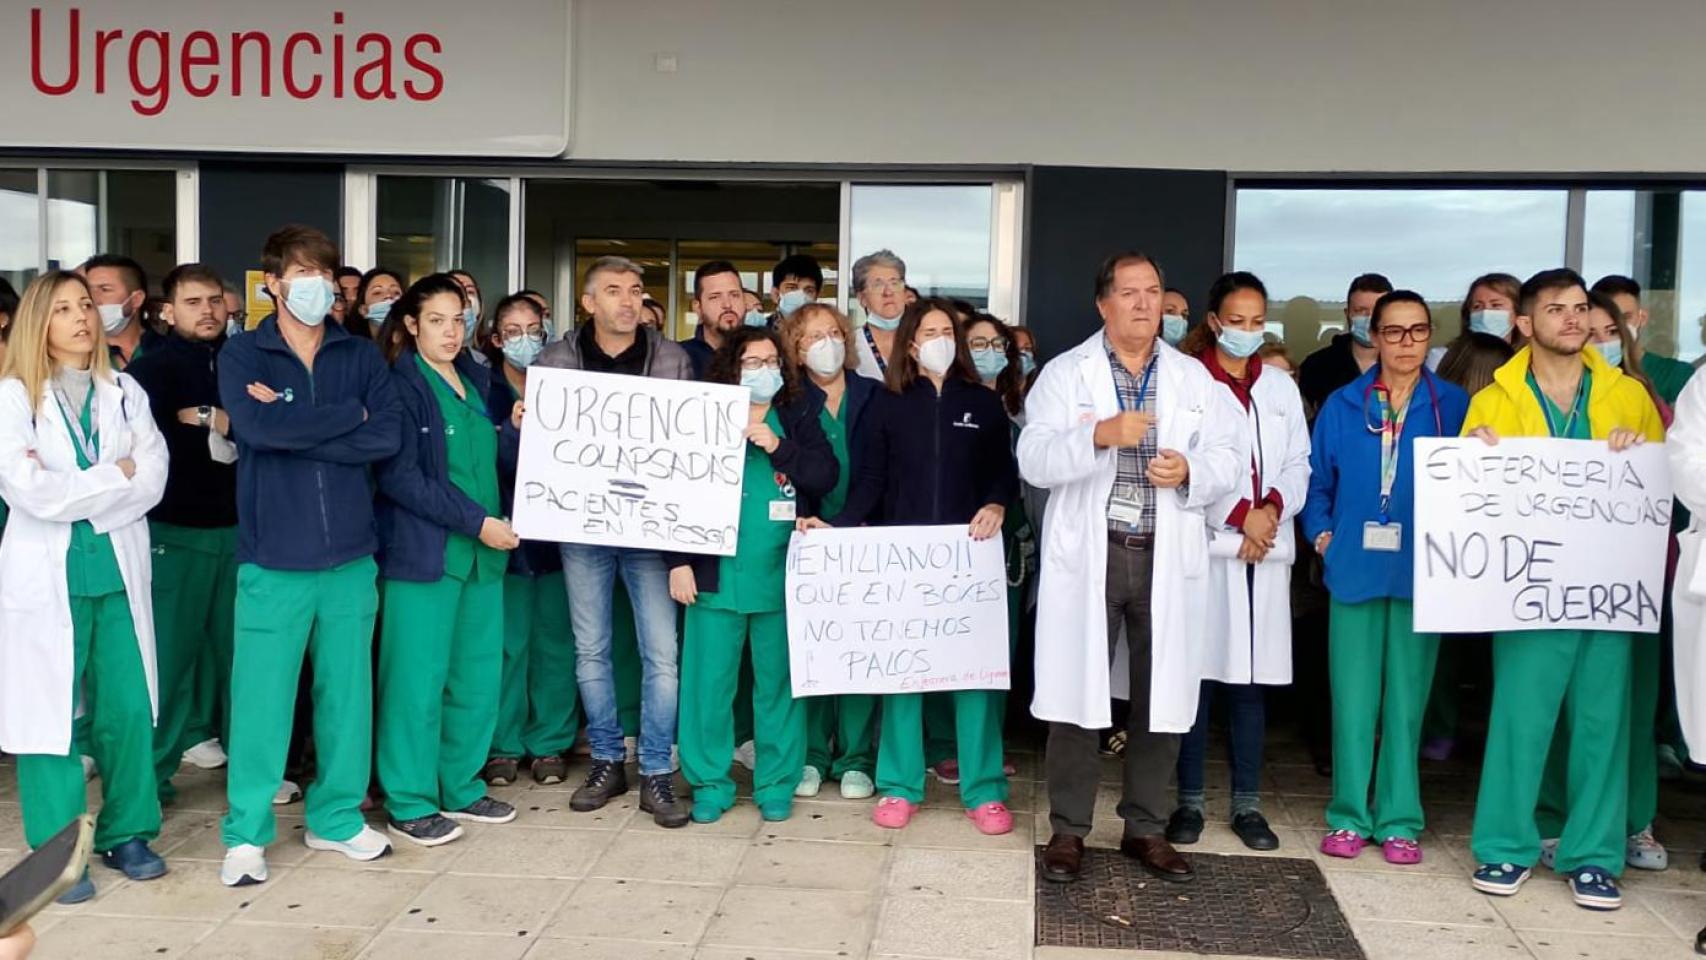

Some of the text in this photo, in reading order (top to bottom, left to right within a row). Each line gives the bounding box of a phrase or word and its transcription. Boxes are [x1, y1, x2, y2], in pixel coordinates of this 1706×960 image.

[31, 8, 445, 116] Urgencias
[553, 440, 740, 485] COLAPSADAS
[1426, 446, 1645, 490] ENFERMERIA
[525, 481, 679, 522] PACIENTES
[1460, 492, 1670, 526] DE URGENCIAS
[583, 519, 737, 549] EN RIESGO
[1425, 531, 1563, 583] NO DE
[796, 581, 852, 605] QUE
[862, 579, 906, 604] EN
[1512, 580, 1659, 625] GUERRA
[804, 616, 972, 642] NO TENEMOS
[839, 649, 931, 680] PALOS
